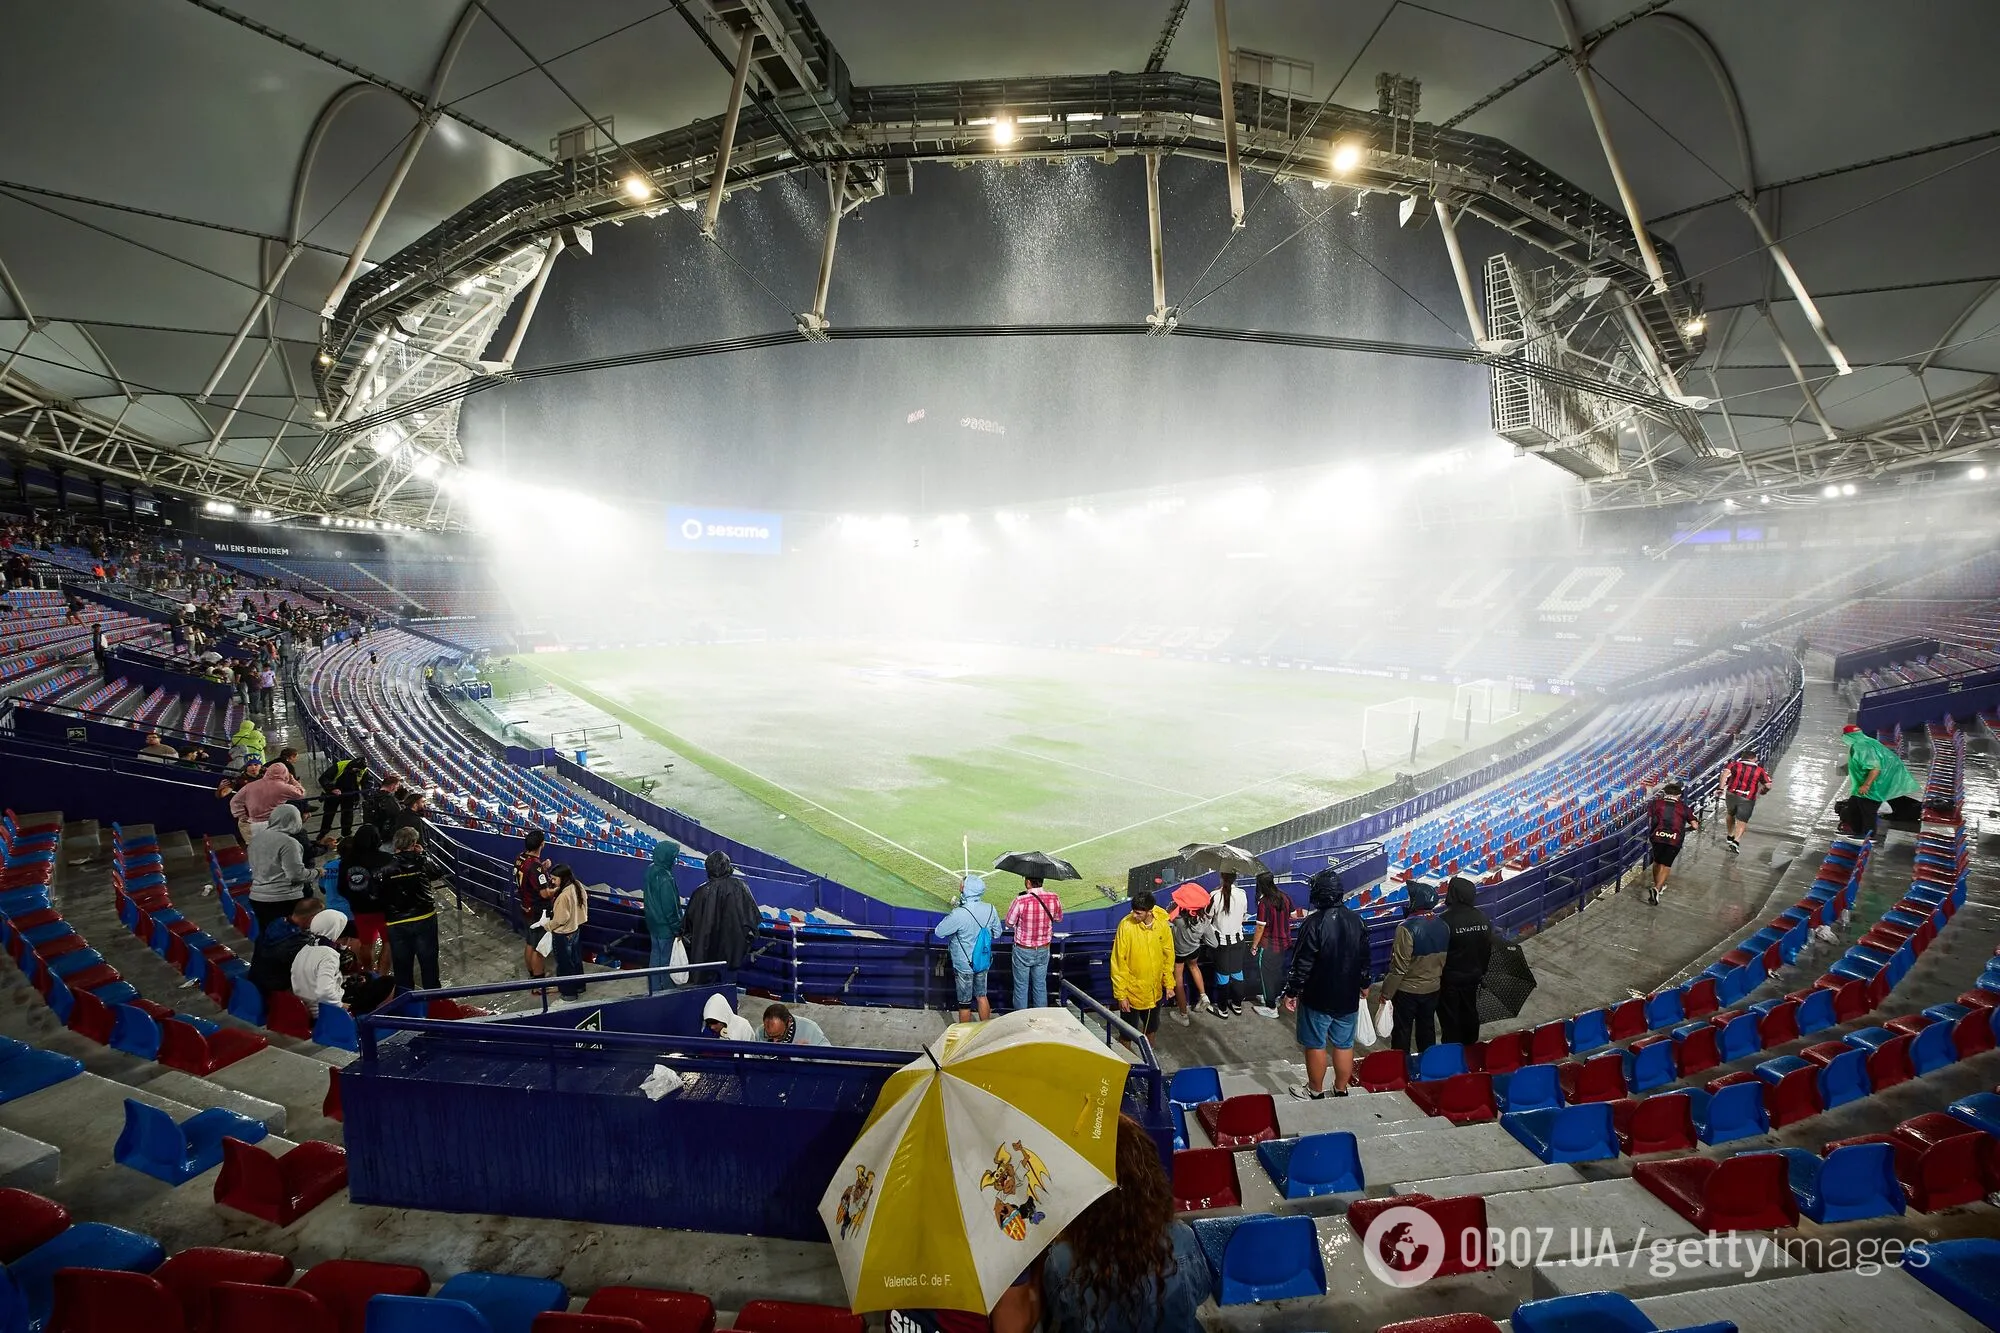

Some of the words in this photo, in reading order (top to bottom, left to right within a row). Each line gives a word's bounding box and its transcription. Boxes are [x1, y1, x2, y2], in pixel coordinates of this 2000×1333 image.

[706, 524, 770, 540] sesame
[214, 543, 229, 552] MAI
[230, 544, 246, 553] ENS
[246, 546, 289, 556] RENDIREM
[1099, 1085, 1109, 1097] de
[1096, 1097, 1106, 1106] C.
[1091, 1107, 1104, 1140] Valencia
[883, 1274, 918, 1288] Valencia
[920, 1273, 929, 1286] C.
[931, 1274, 943, 1286] de
[944, 1274, 953, 1286] F.
